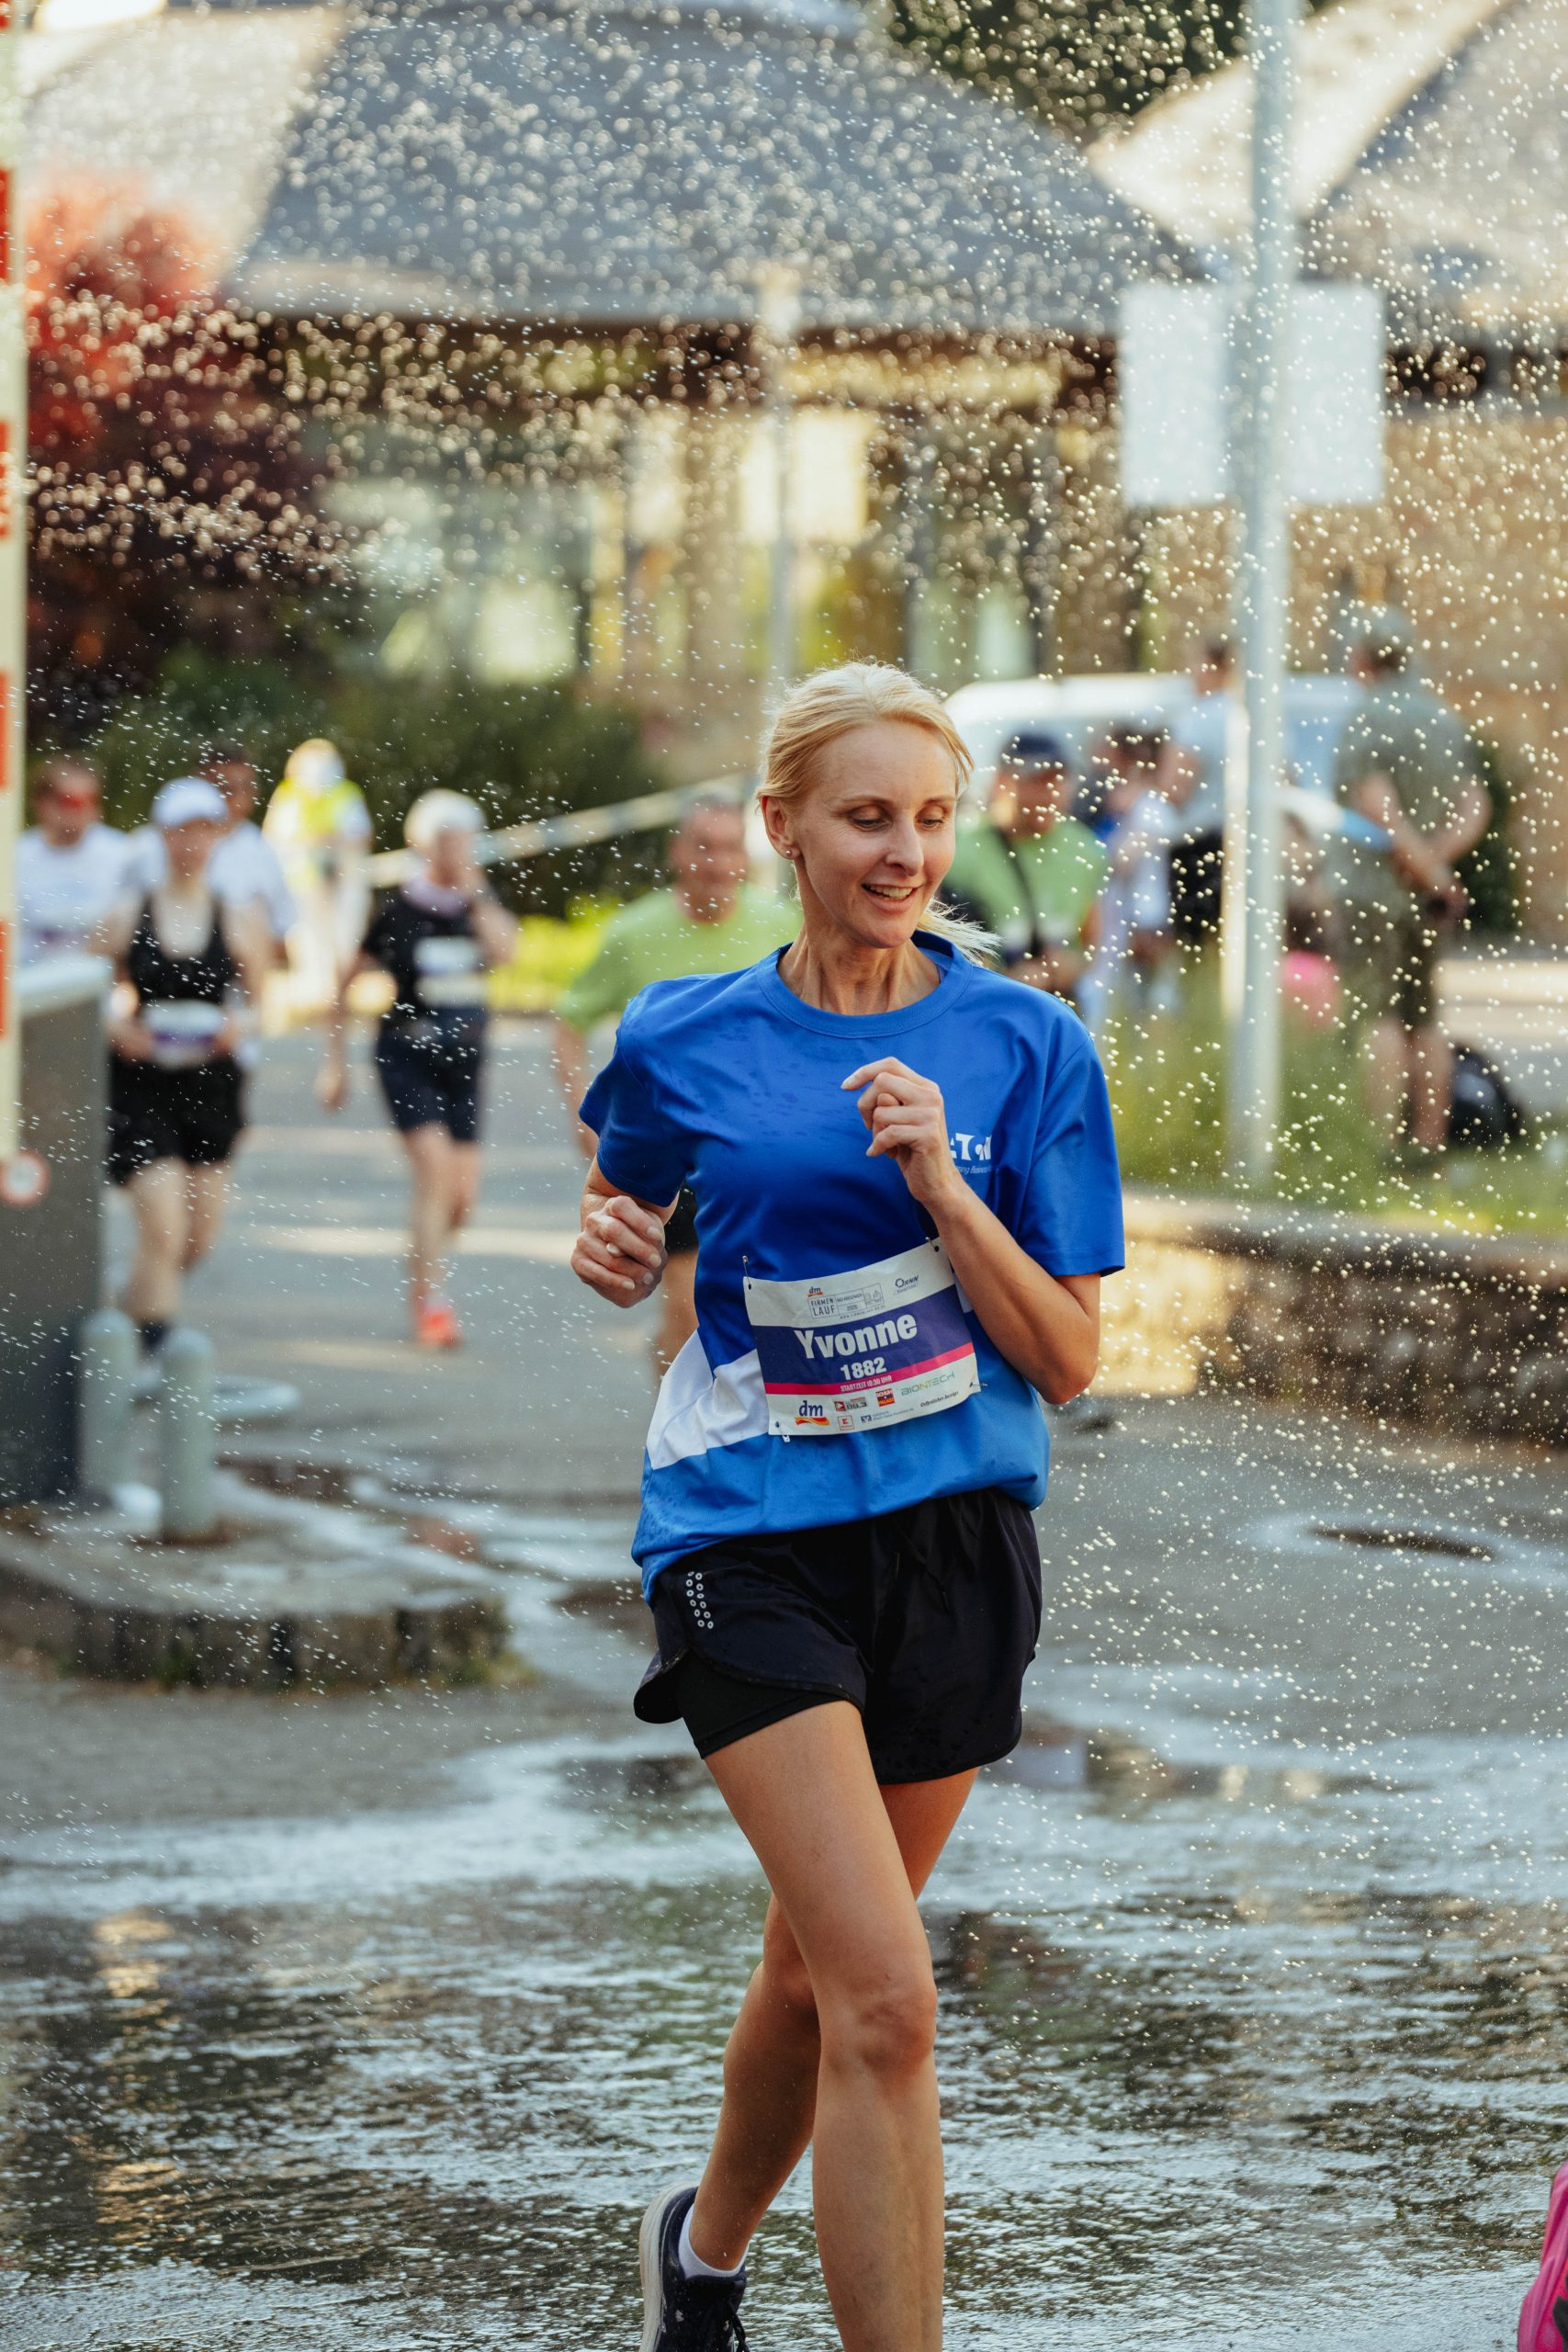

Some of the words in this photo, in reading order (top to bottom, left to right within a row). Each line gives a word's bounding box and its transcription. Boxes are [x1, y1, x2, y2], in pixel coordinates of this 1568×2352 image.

[810, 1297, 834, 1306] FIRMEN
[813, 1305, 836, 1317] LAUF
[794, 1314, 918, 1360] Yvonne
[840, 1357, 887, 1381] 1882
[840, 1381, 866, 1392] STARTZEIT
[880, 1374, 893, 1384] UHR
[900, 1371, 955, 1396] BIONTECH
[798, 1400, 823, 1418] dm
